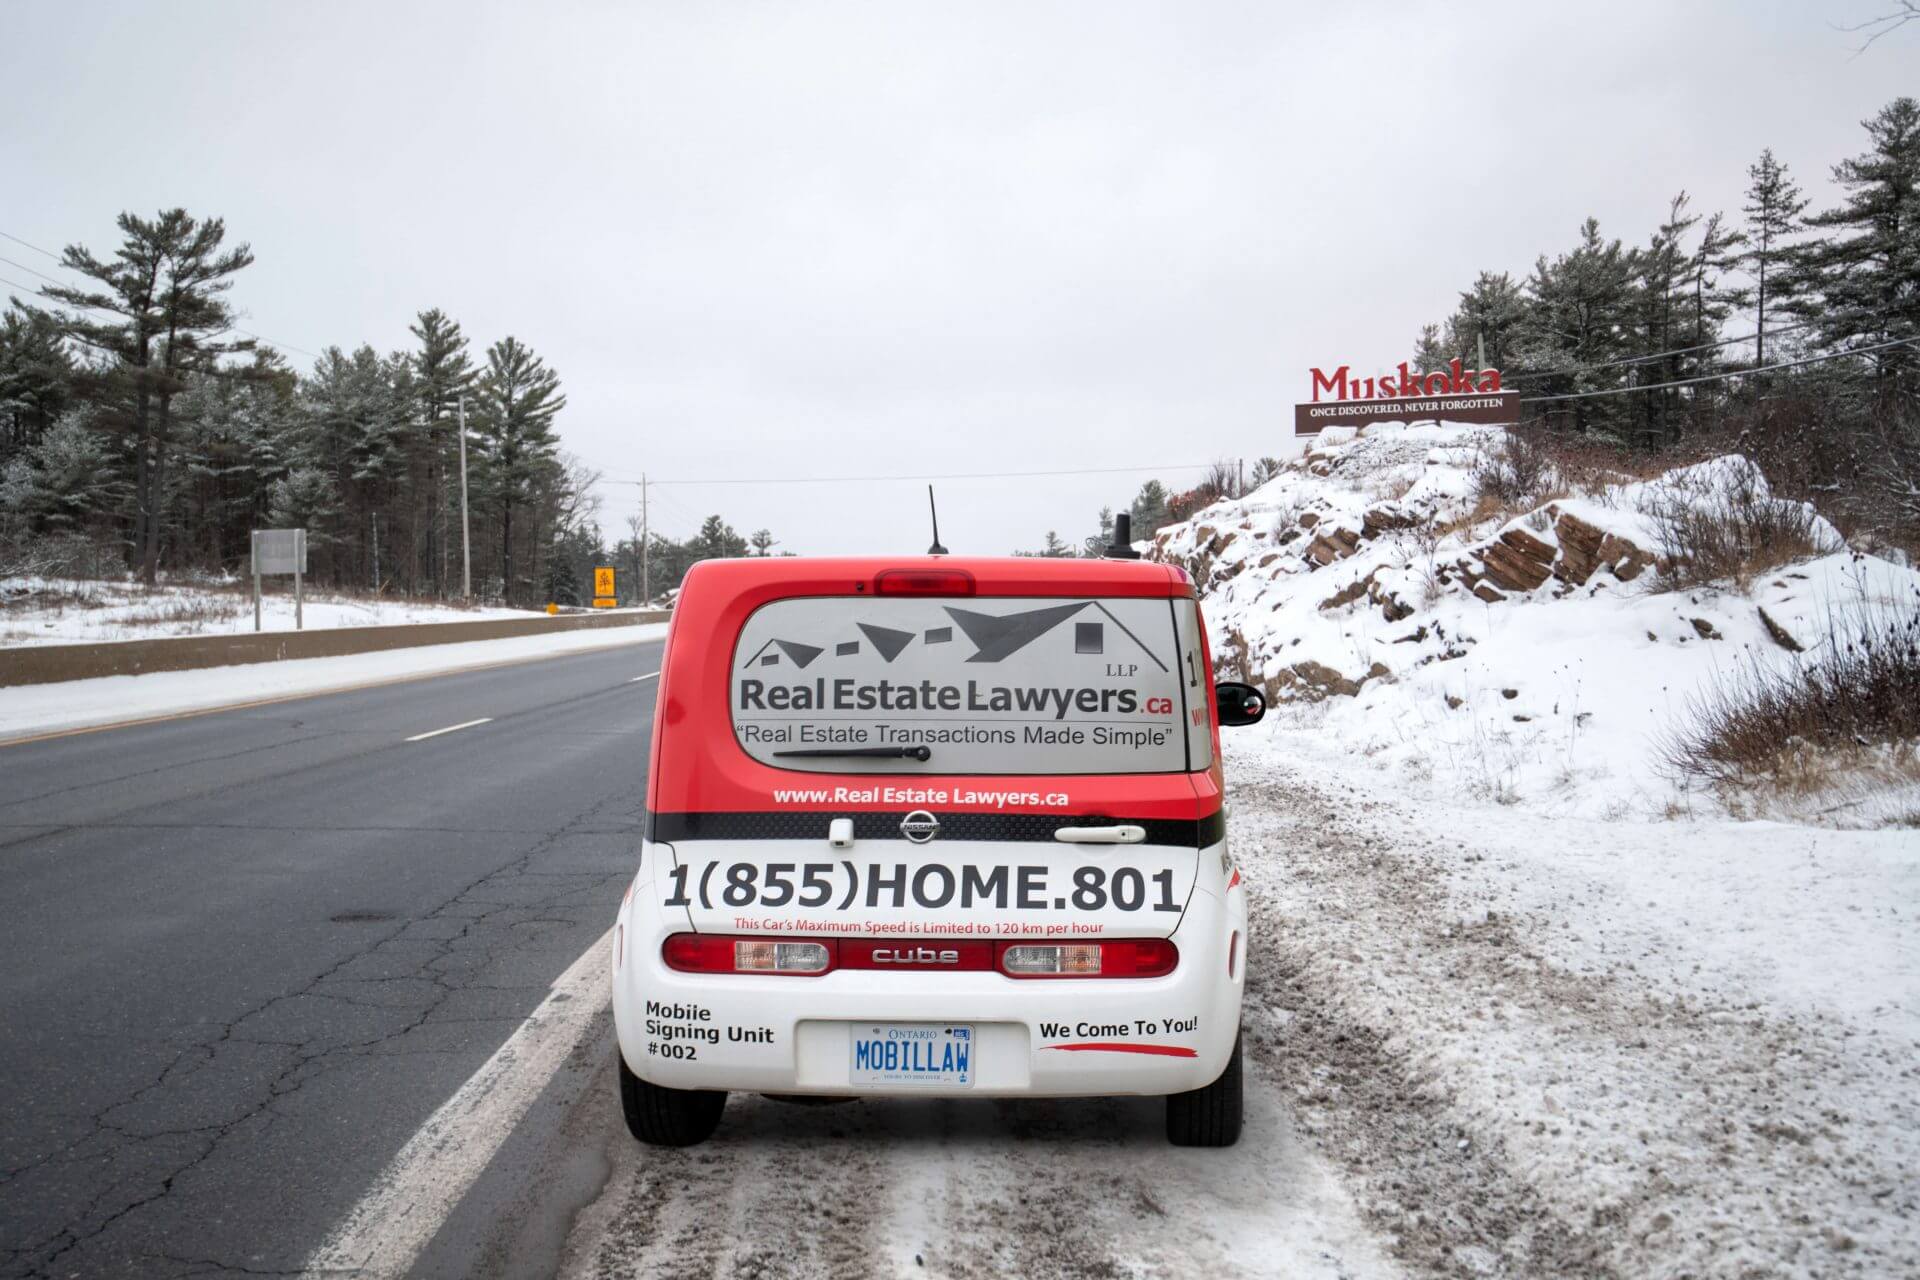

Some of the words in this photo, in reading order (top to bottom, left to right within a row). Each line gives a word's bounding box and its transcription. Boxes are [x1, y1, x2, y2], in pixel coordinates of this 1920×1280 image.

[1309, 357, 1502, 402] Muskoka
[1310, 406, 1337, 417] ONCE
[1338, 403, 1404, 416] DISCOVERED,
[1405, 402, 1439, 412] NEVER
[1440, 398, 1504, 410] FORGOTTEN
[1105, 663, 1138, 677] LLP
[800, 725, 869, 743] Estate
[875, 725, 1016, 744] Transactions
[1024, 726, 1085, 745] Made
[664, 861, 1183, 912] 1(855)HOME.801
[734, 917, 760, 930] This
[796, 920, 862, 933] Maximum
[865, 921, 907, 935] Speed
[909, 921, 920, 933] is
[923, 922, 974, 934] Limited
[977, 923, 991, 934] to
[996, 923, 1019, 934] 120
[1022, 922, 1043, 934] km
[1046, 923, 1070, 936] per
[1072, 922, 1104, 934] hour
[872, 947, 959, 965] cube
[646, 1019, 720, 1045] Signing
[727, 1026, 775, 1043] Unit
[888, 1029, 938, 1040] ONTARIO
[1040, 1023, 1071, 1038] We
[1076, 1022, 1130, 1038] Come
[1134, 1020, 1157, 1036] To
[1162, 1016, 1199, 1034] You!
[647, 1041, 698, 1061] #002
[856, 1040, 969, 1072] MOBILLAW
